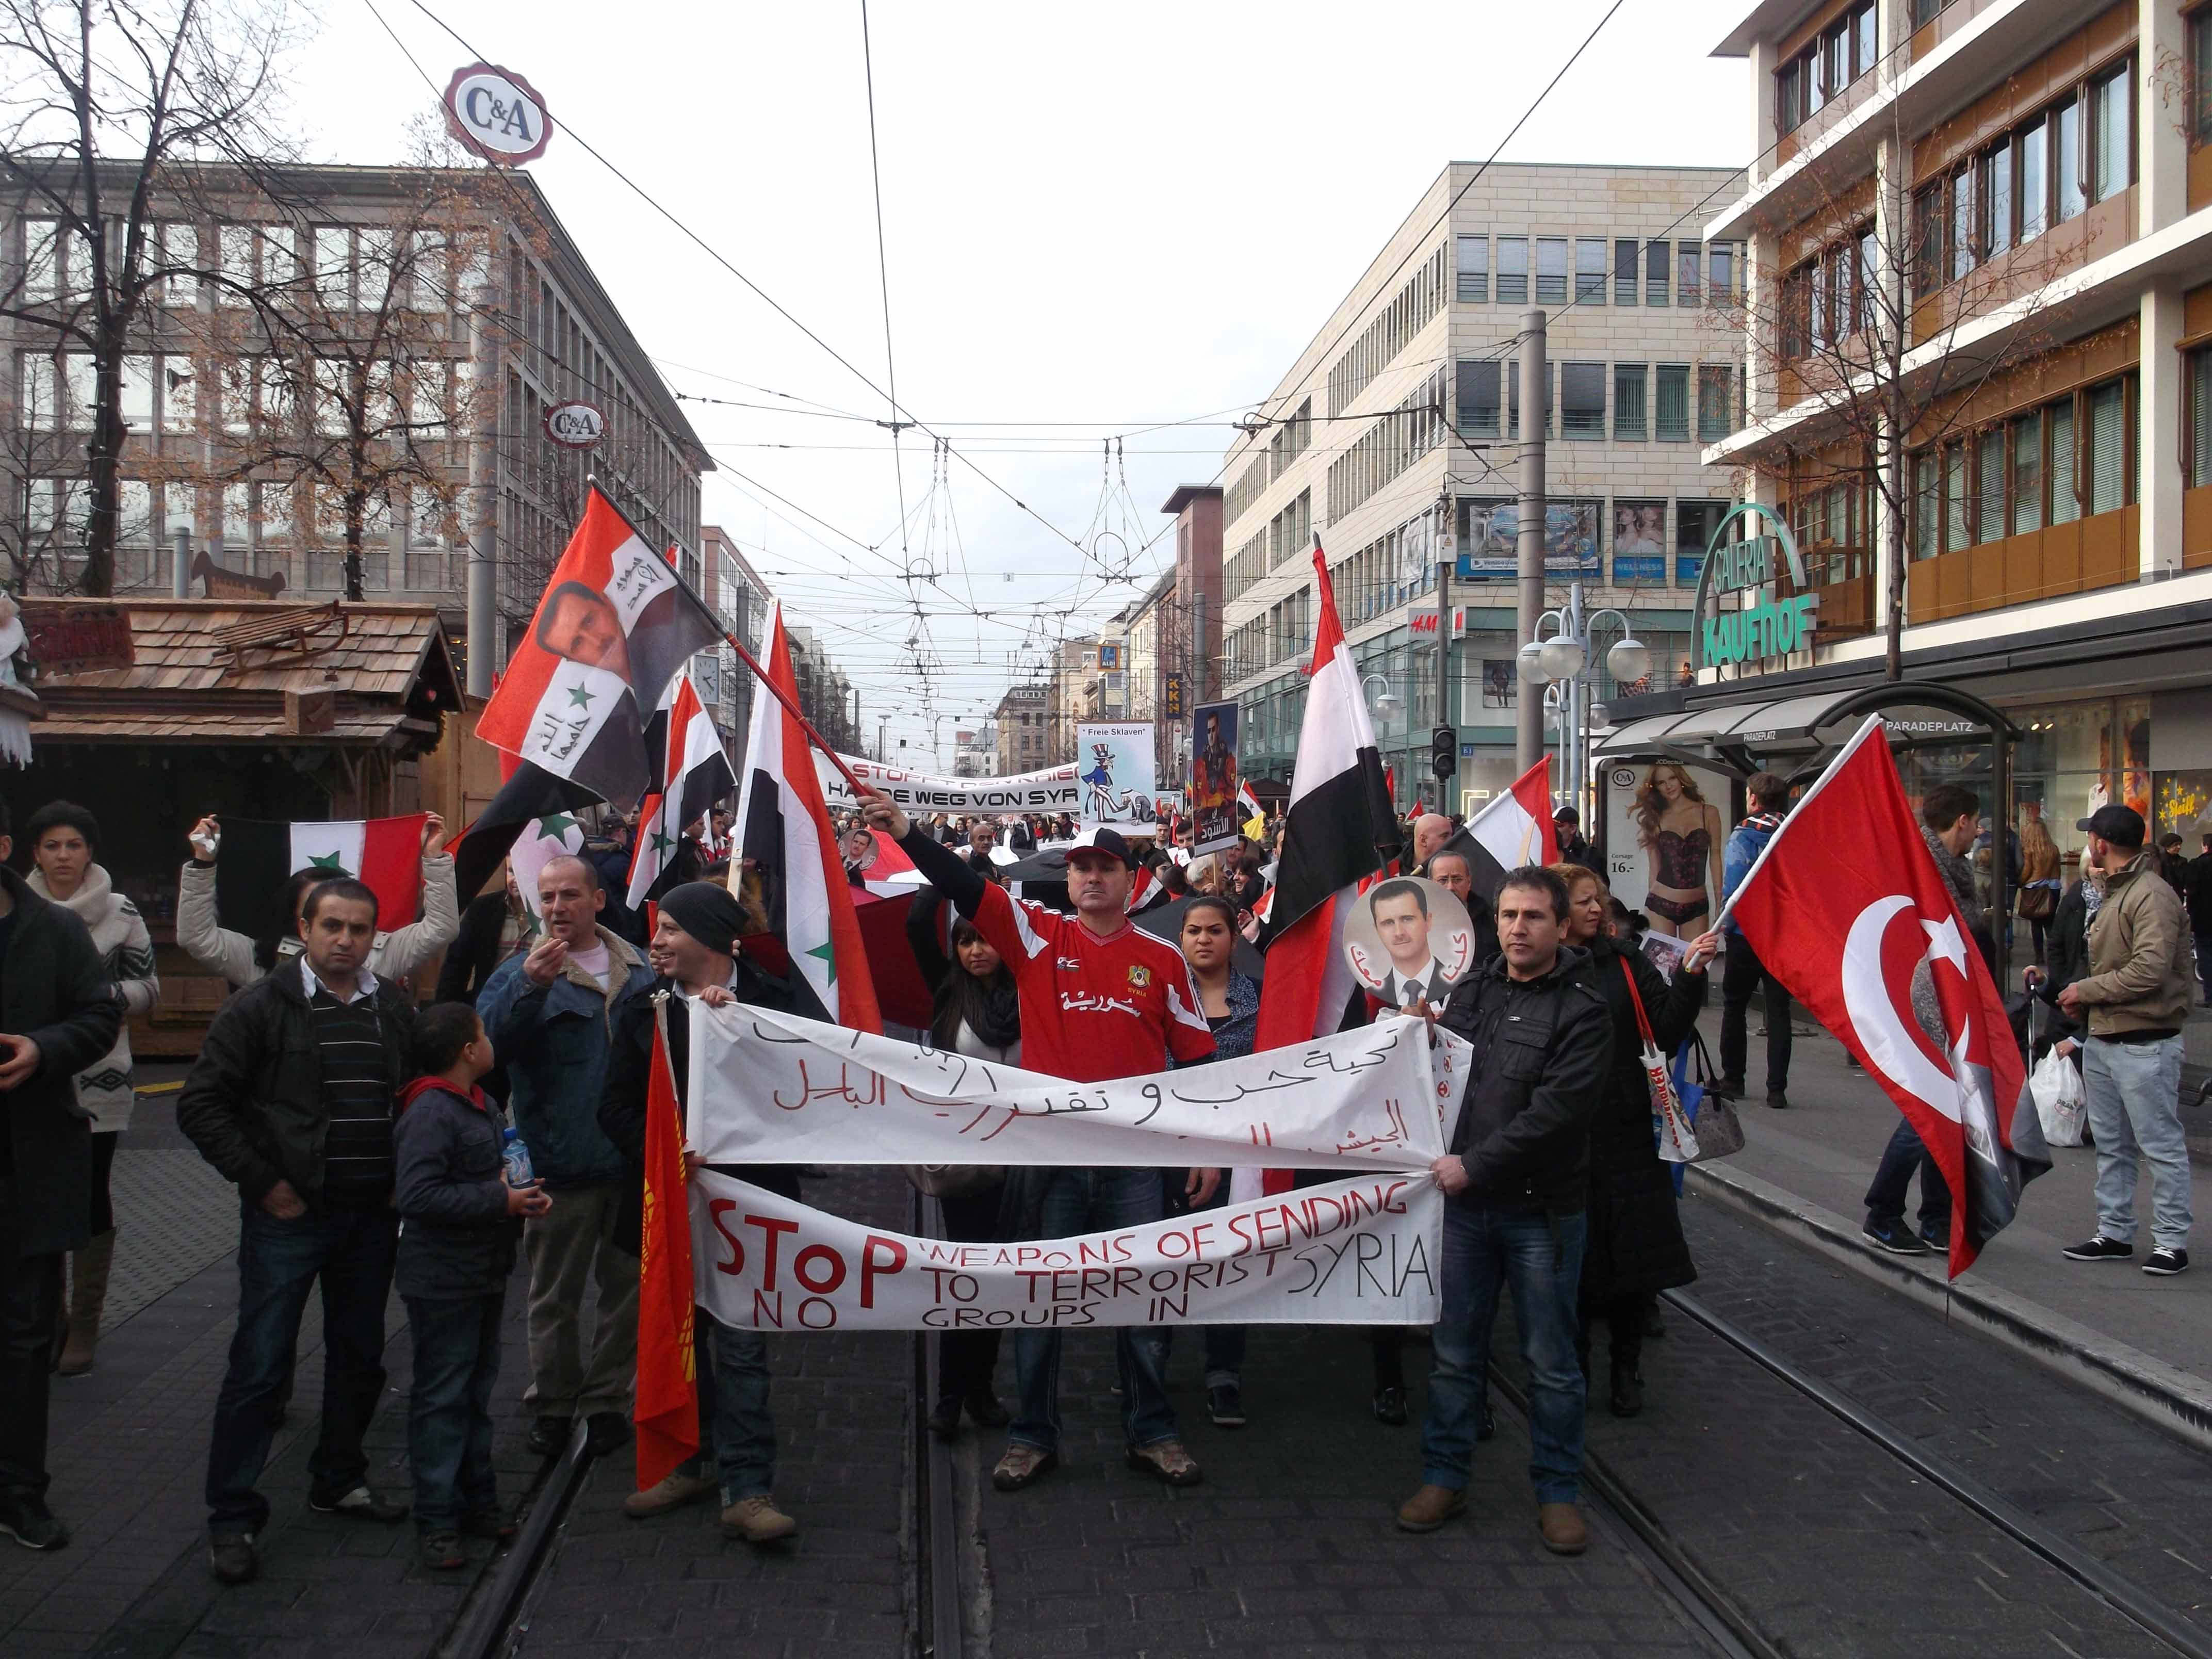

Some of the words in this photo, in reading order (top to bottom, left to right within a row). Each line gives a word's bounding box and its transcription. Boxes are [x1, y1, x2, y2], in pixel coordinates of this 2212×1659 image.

[466, 86, 534, 143] C&A
[554, 413, 598, 436] C&A
[1713, 535, 1768, 594] GALERIA
[1410, 614, 1438, 633] H&M
[1088, 728, 1109, 736] Freie
[1743, 730, 1776, 742] PARADEPLATZ
[1886, 722, 1974, 732] PARADEPLATZ
[1018, 766, 1079, 785] KRIE
[915, 790, 967, 806] WEG
[972, 791, 1022, 806] VON
[1611, 862, 1635, 873] 16.-
[1127, 987, 1147, 998] SYRIA
[708, 1197, 908, 1310] STOP
[919, 1233, 1136, 1269] WEAPONS
[1157, 1223, 1215, 1261] OF
[1227, 1181, 1408, 1259] SENDING
[920, 1266, 980, 1304] TO
[1014, 1246, 1292, 1304] TERRORIST
[1288, 1232, 1435, 1298] SYRIA
[753, 1288, 837, 1329] NO
[921, 1302, 1102, 1327] GROUPS
[1148, 1292, 1189, 1322] IN
